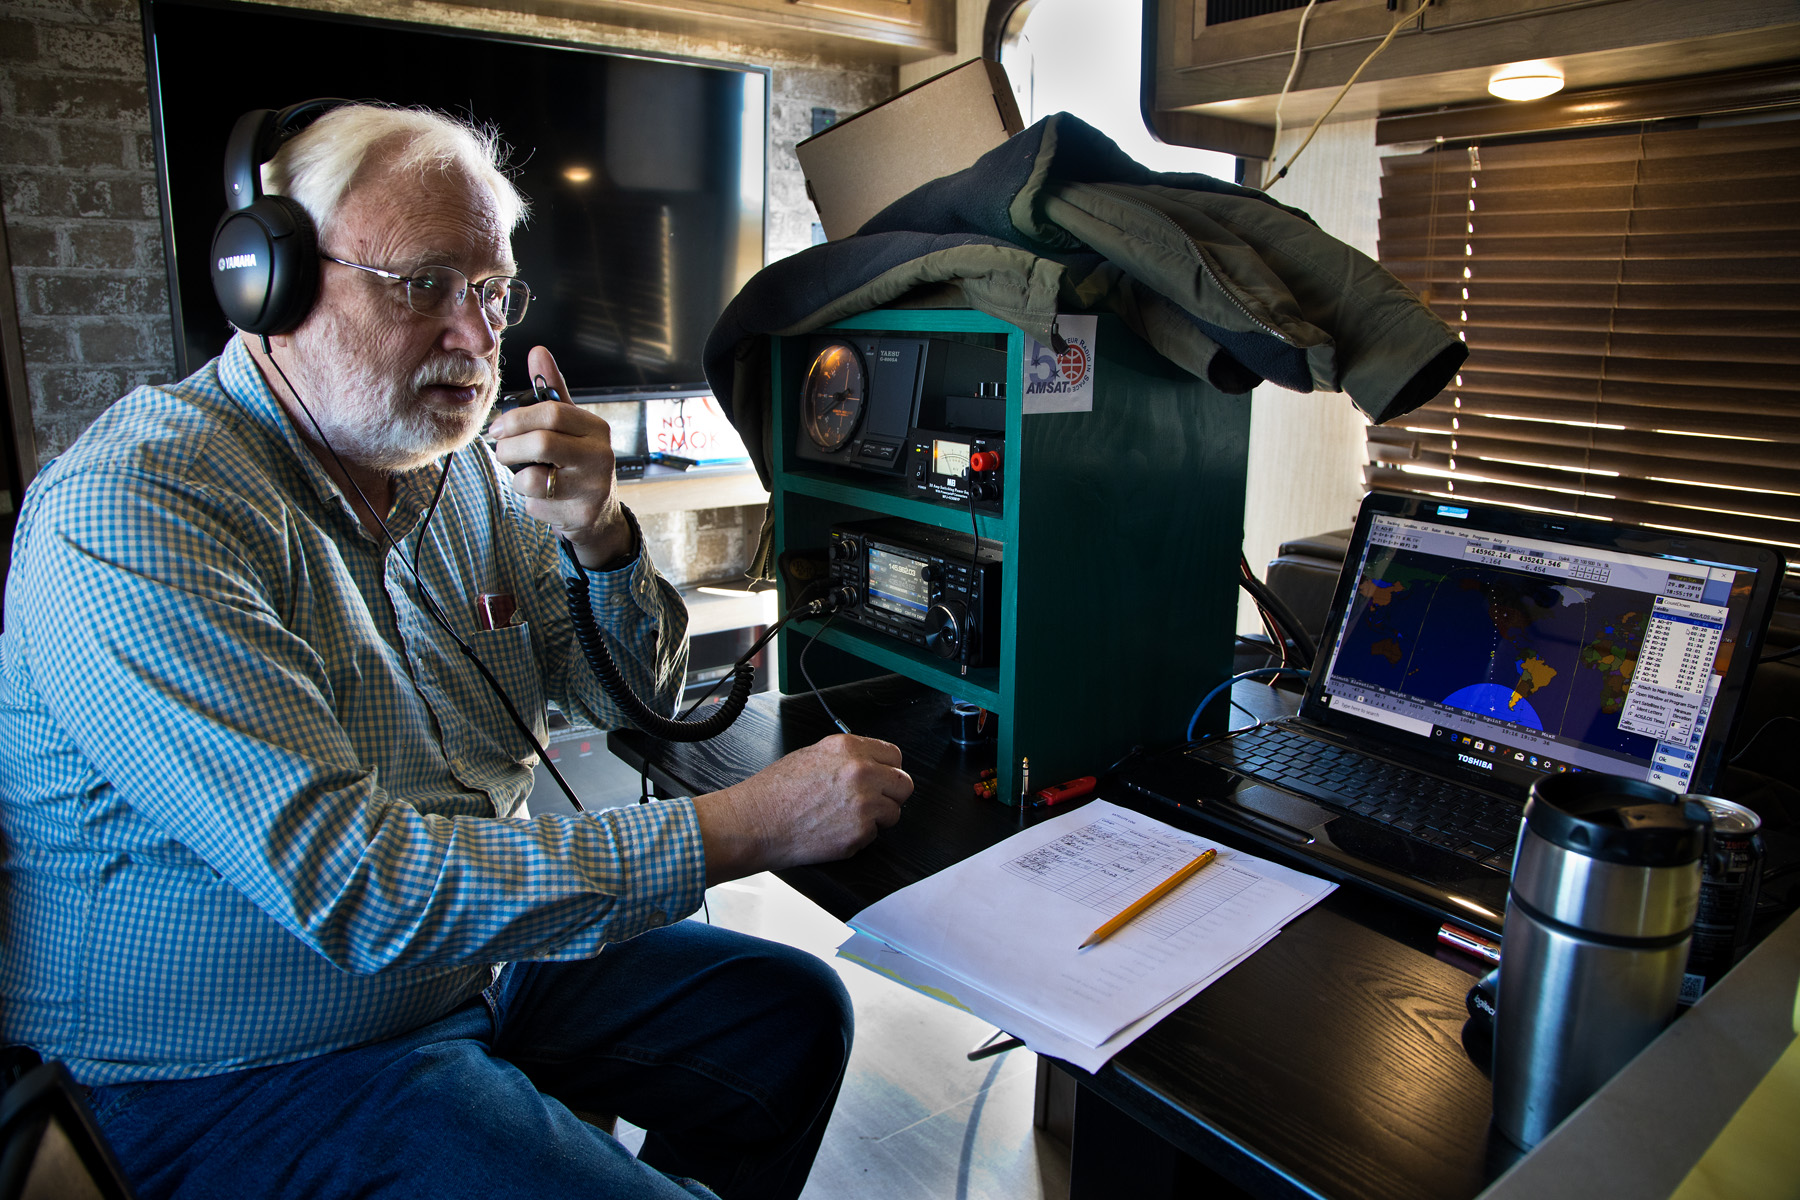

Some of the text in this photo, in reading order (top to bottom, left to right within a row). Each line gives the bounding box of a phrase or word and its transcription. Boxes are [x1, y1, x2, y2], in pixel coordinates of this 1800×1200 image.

[225, 253, 257, 269] YAMAHA
[1026, 381, 1070, 394] AMSAT
[662, 416, 692, 428] NOT
[1471, 547, 1562, 568] 145962.164 435243.546
[1480, 556, 1546, 574] 2.164 -6.454
[1668, 582, 1702, 592] 29.09.2019
[1666, 589, 1693, 597] 18:55:19
[1664, 600, 1691, 609] CountDown
[1636, 691, 1647, 699] Open
[1648, 694, 1664, 702] Window
[1669, 699, 1686, 707] Program
[1390, 689, 1407, 699] Height
[1445, 704, 1454, 712] Lat
[1462, 710, 1478, 719] Orbit
[1483, 715, 1502, 725] Squint
[1648, 708, 1663, 717] Letters
[1674, 708, 1692, 716] Minimum
[1366, 709, 1380, 718] search
[1672, 714, 1692, 722] Elevation
[1502, 728, 1519, 737] 19:16
[1458, 753, 1493, 770] TOSHIBA
